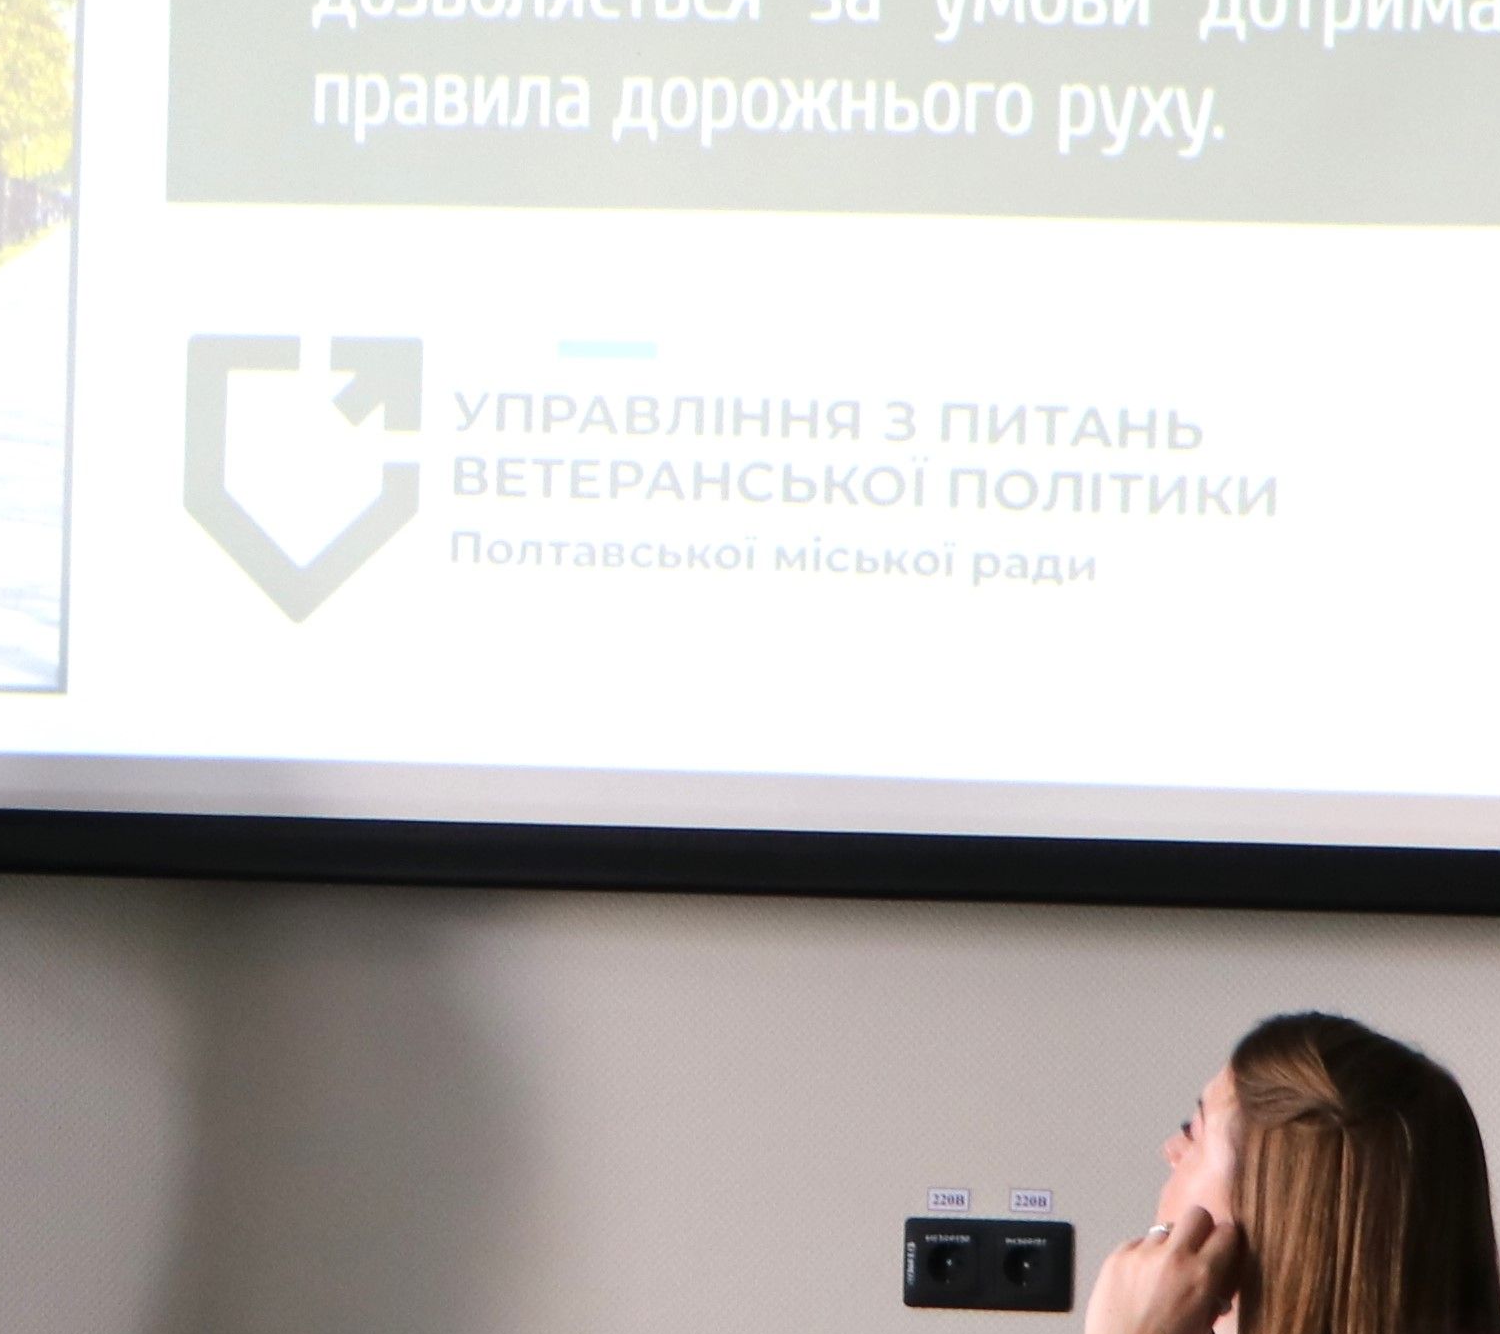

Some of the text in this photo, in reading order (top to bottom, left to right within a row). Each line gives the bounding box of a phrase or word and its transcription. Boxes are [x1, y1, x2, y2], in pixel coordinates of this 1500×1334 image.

[312, 72, 1226, 161] правила дорожнього руху.
[452, 389, 1205, 454] УПРАВЛІННЯ З ПИТАНЬ
[450, 453, 1279, 520] ВЕТЕРАНСЬКОЇ ПОЛІТИКИ
[448, 527, 1098, 589] Полтавської міської ради
